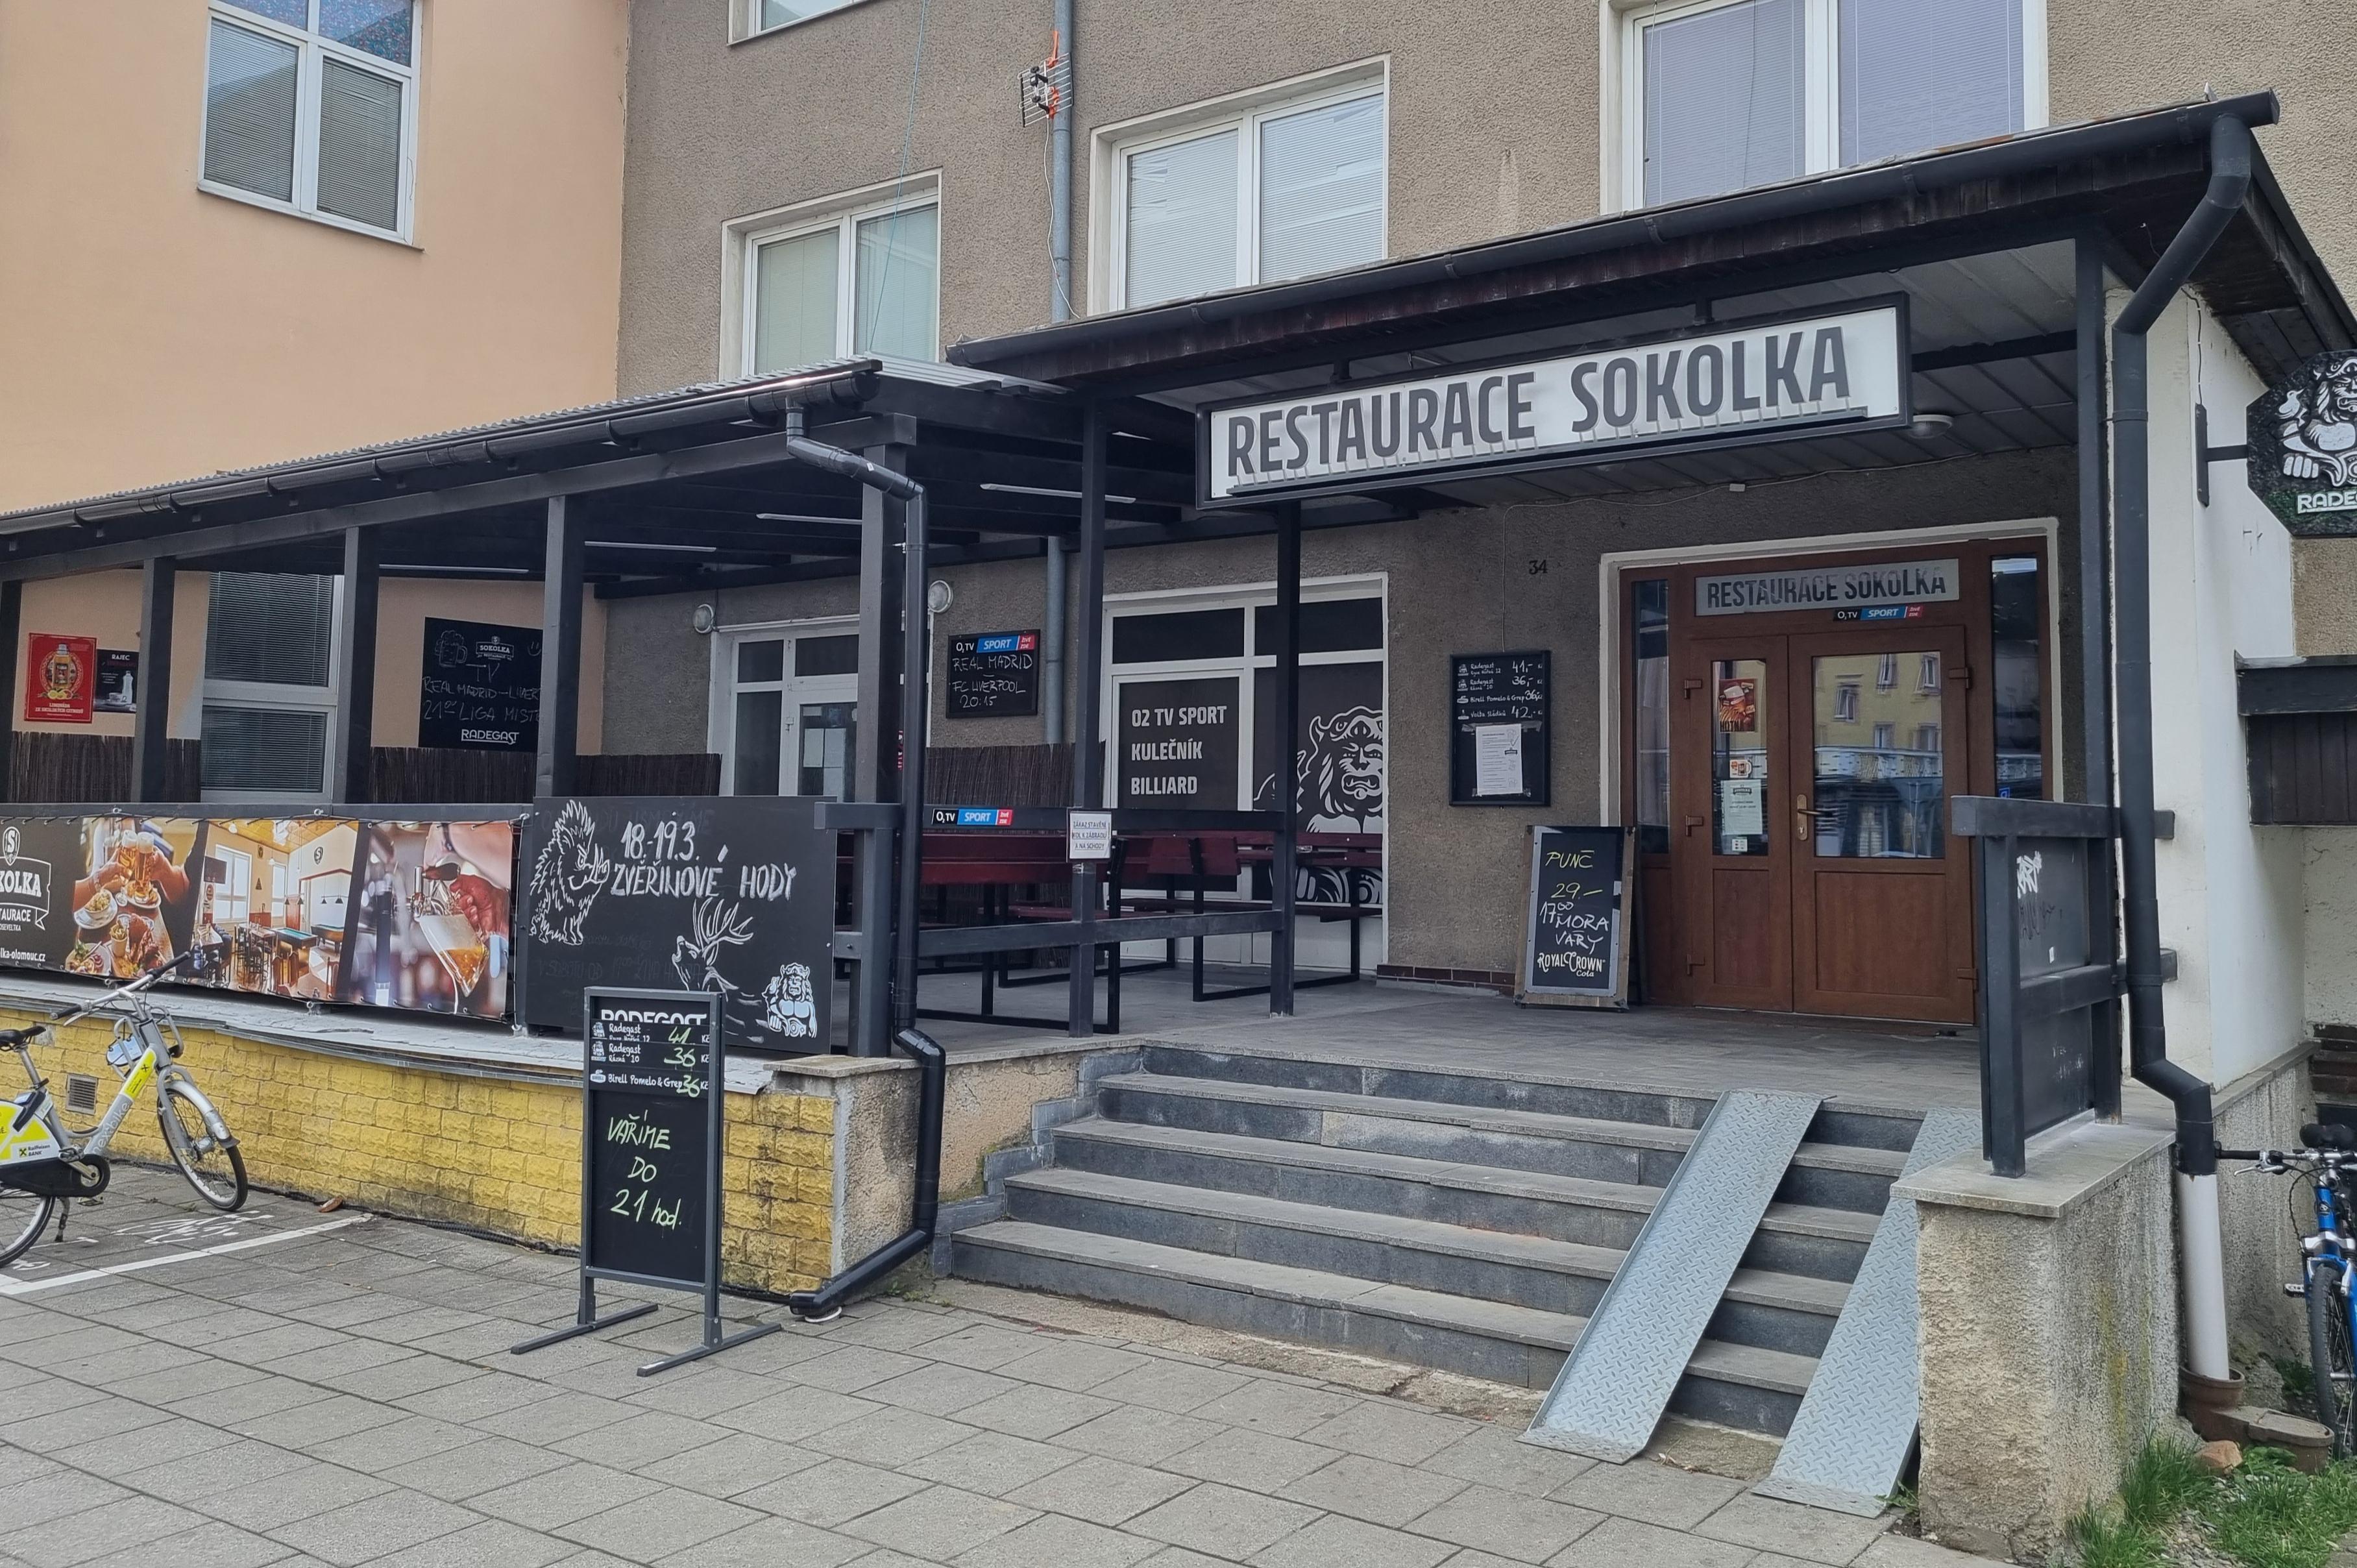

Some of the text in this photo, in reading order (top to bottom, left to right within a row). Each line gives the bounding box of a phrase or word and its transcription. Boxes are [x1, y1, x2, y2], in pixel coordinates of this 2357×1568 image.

[1228, 326, 1851, 477] RESTAURACE SOKOLKA
[2297, 491, 2357, 513] RADE
[1529, 559, 1547, 574] 34
[1707, 567, 1946, 608] RESTAURACE SOKOLKA
[1868, 608, 1899, 617] SPORT
[480, 645, 510, 654] SOKOLKA
[983, 639, 1012, 650] SPORT
[952, 654, 1033, 672] REAL MADRID
[422, 676, 455, 694] REAL
[952, 680, 1026, 694] FC LIVERPOOL
[960, 694, 997, 708] 20:15
[459, 702, 495, 720] LIGA
[1132, 705, 1227, 727] O2 TV SPORT
[461, 729, 520, 745] RADEGAST
[1131, 738, 1203, 761] KULEČNÍK
[1131, 776, 1197, 795] BILLIARD
[964, 812, 992, 822] SPORT
[610, 844, 798, 901] ZVĚŘINOVÉ HODY
[1555, 913, 1609, 931] MORA
[0, 948, 46, 962] lka-olomouc.cz
[1537, 951, 1603, 972] ROYAL CROWN
[609, 1023, 641, 1036] Radegast
[668, 1026, 692, 1044] 41
[609, 1044, 709, 1068] Radegast 36 Kč
[608, 1073, 628, 1084] Birell
[630, 1075, 657, 1086] Pomelo
[657, 1078, 663, 1086] &
[663, 1077, 682, 1089] Grep
[700, 1081, 709, 1090] Kč
[607, 1109, 671, 1149] VAŘÍME
[628, 1156, 657, 1182] DO
[610, 1189, 682, 1231] 21 hod.
